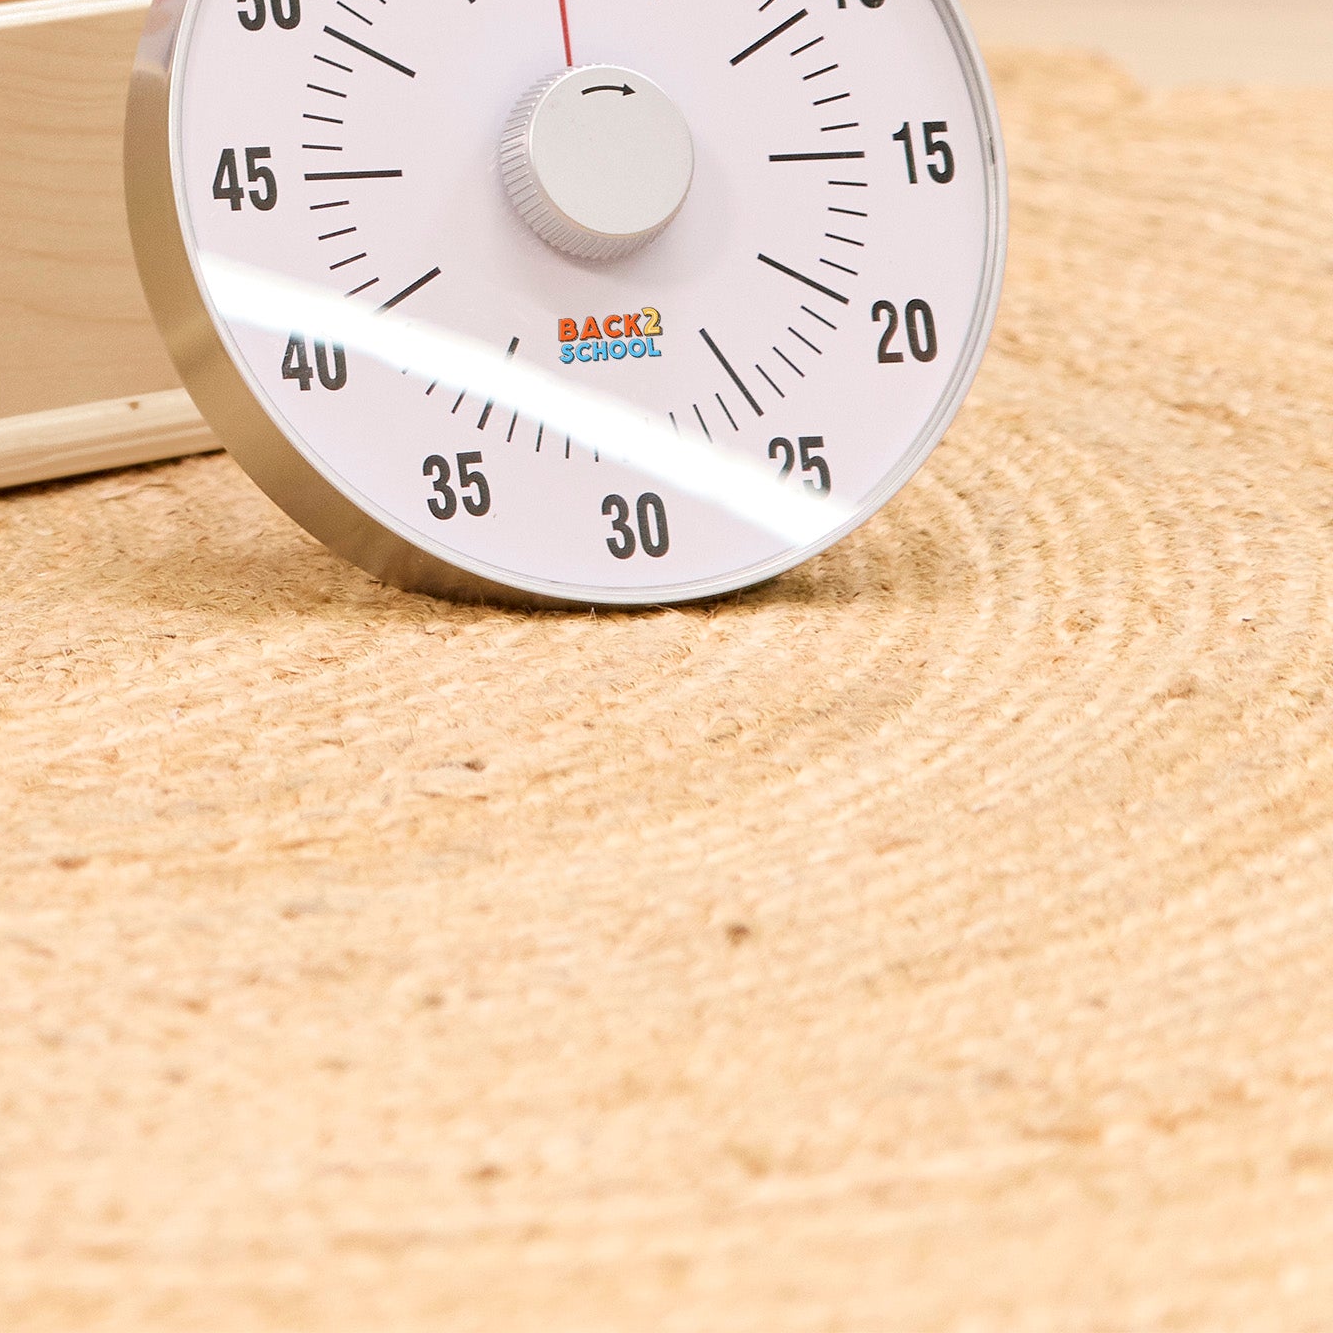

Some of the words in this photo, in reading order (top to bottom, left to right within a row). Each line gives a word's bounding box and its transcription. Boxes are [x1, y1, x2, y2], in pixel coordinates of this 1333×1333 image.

[212, 146, 278, 212] 45
[892, 120, 955, 185] 15
[281, 330, 347, 391] 40
[559, 337, 662, 365] SCHOOL
[871, 298, 938, 364] 20
[422, 450, 491, 520] 35
[767, 435, 831, 500] 25
[601, 492, 670, 560] 30
